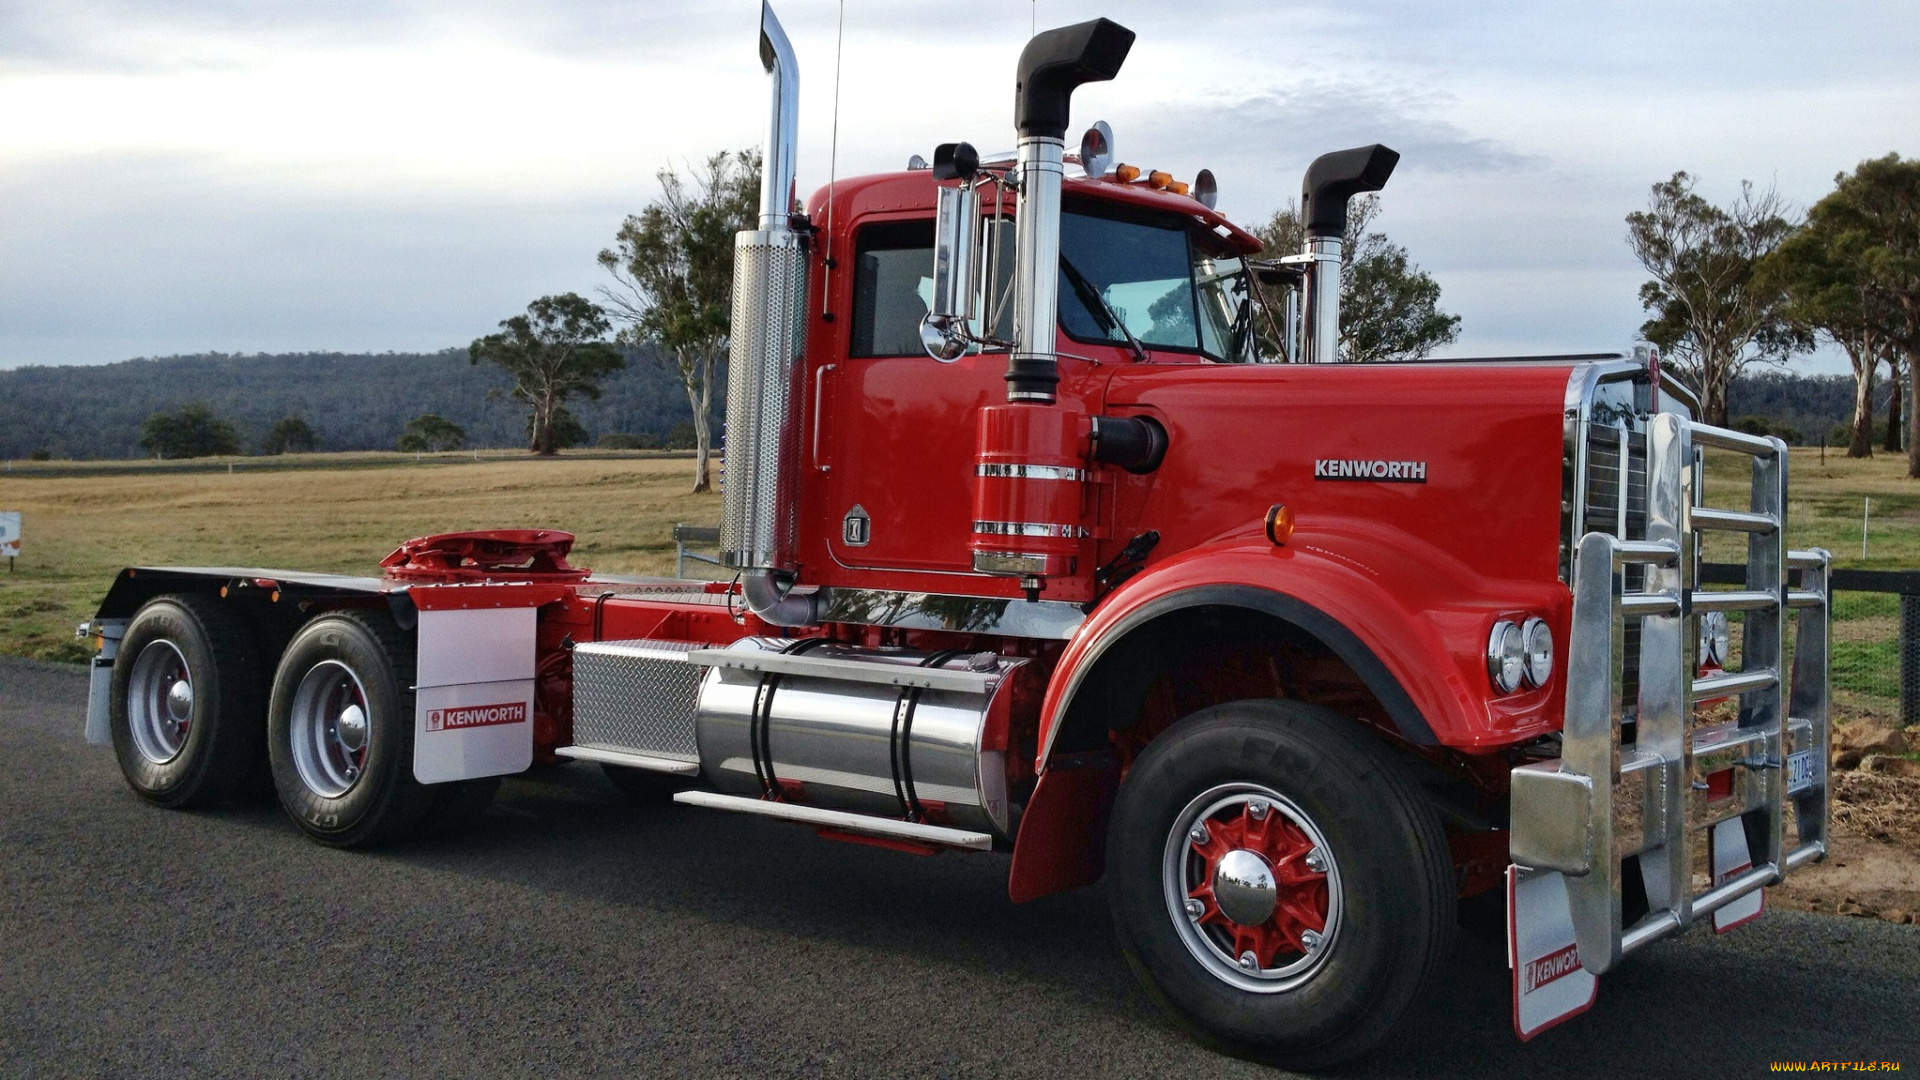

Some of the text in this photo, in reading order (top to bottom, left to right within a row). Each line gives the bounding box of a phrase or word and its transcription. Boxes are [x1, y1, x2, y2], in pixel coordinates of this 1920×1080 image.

[1314, 459, 1426, 480] KENWORTH
[446, 705, 523, 726] KENWORTH
[1536, 949, 1580, 984] KENWOR
